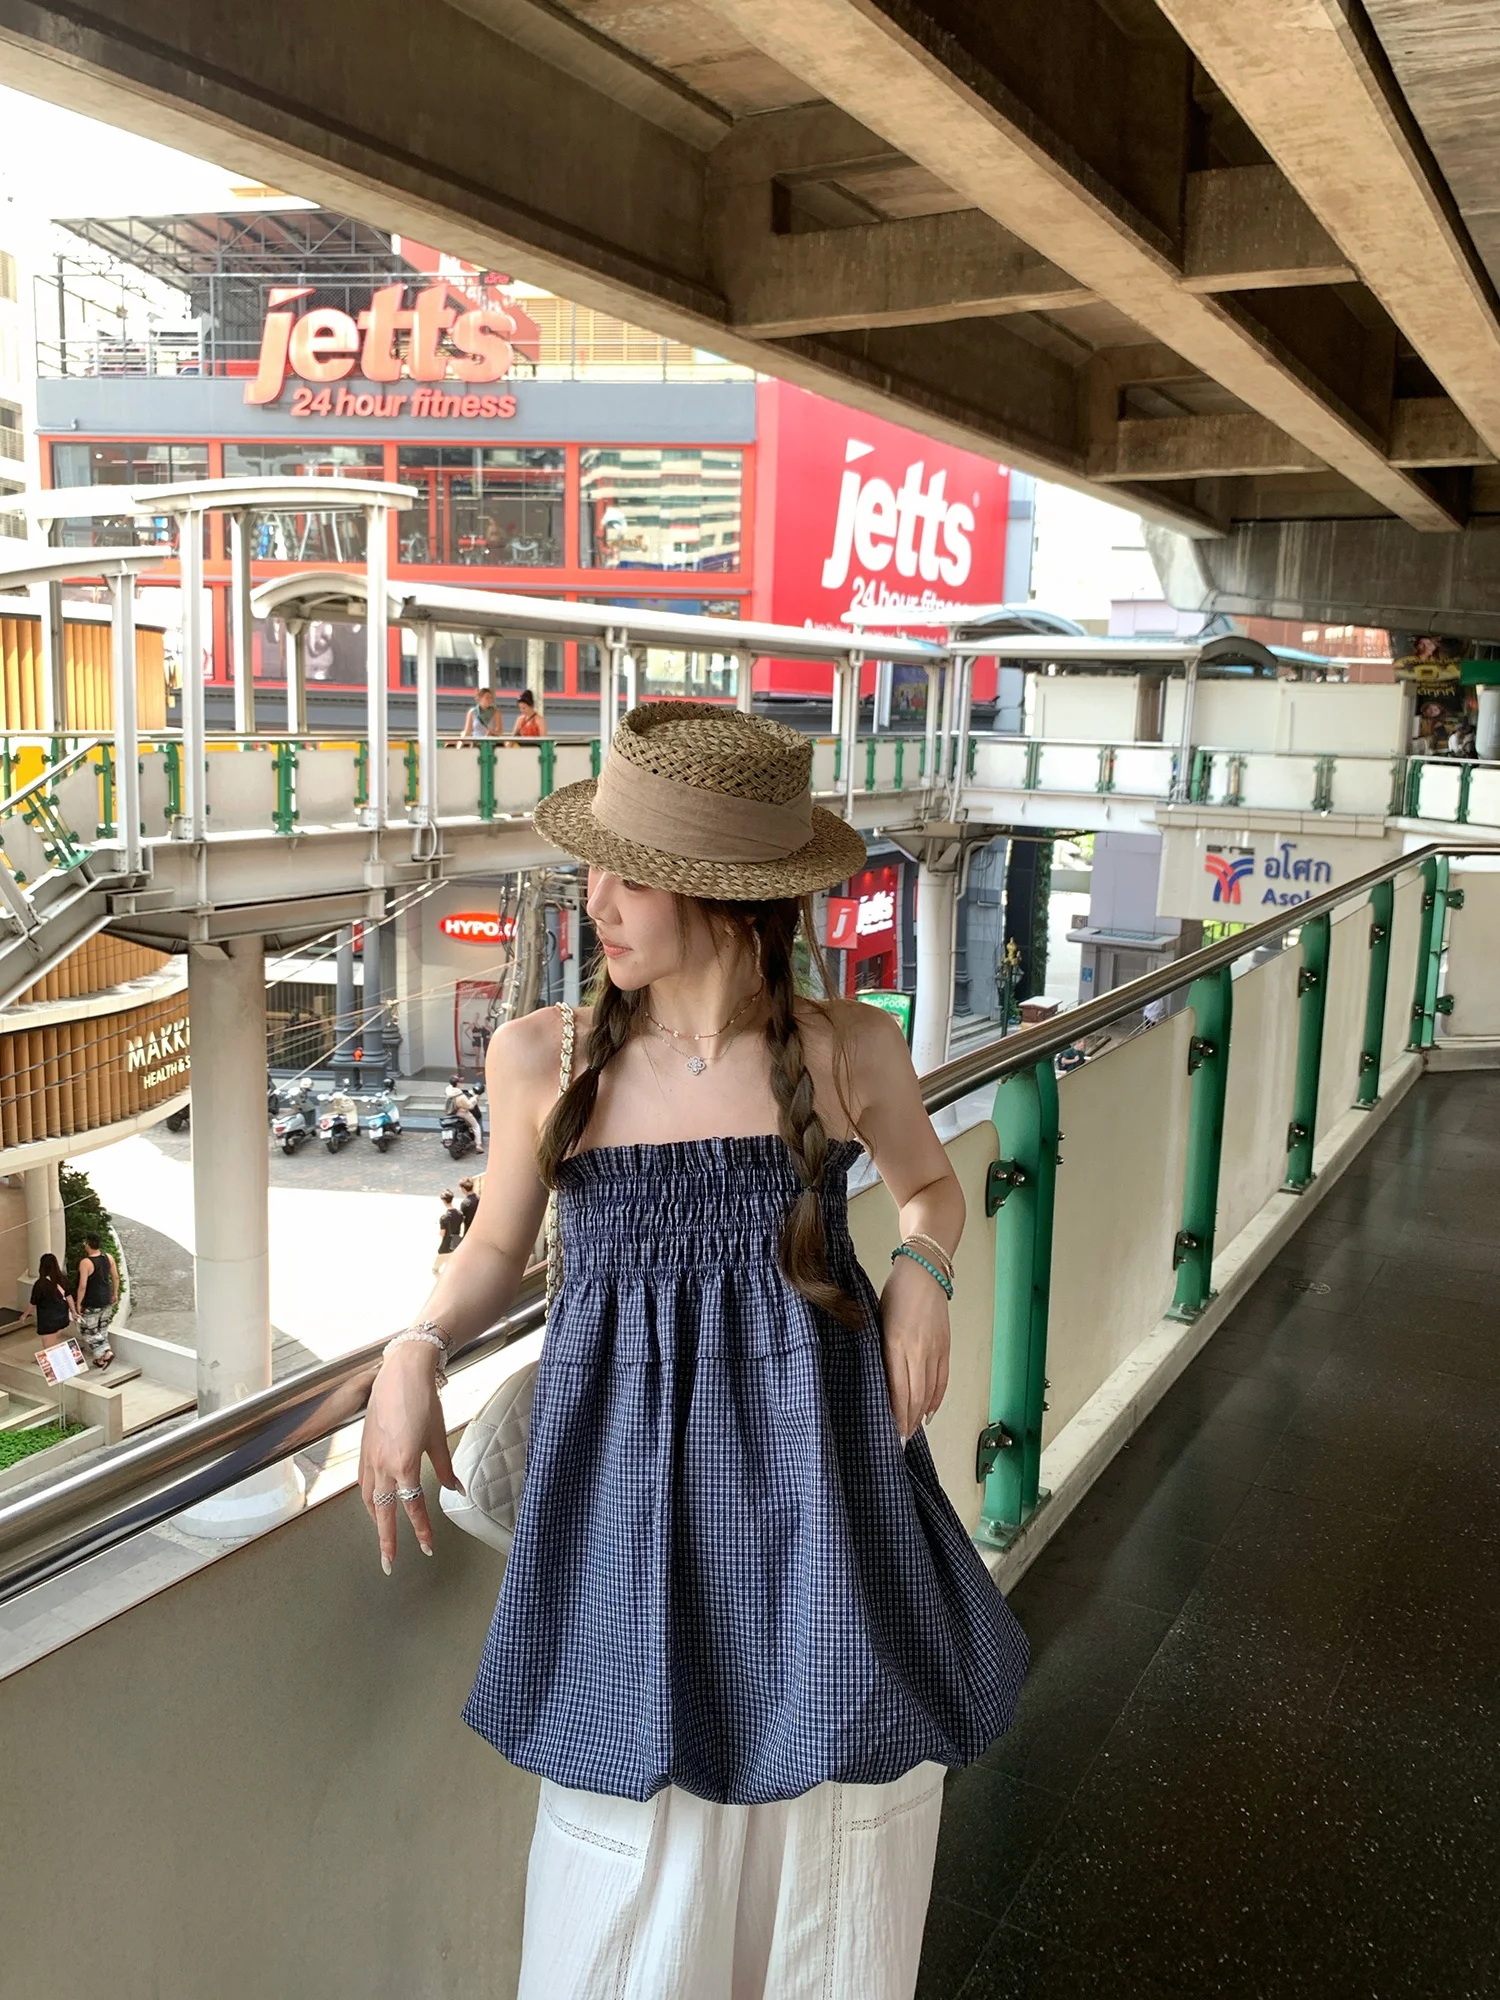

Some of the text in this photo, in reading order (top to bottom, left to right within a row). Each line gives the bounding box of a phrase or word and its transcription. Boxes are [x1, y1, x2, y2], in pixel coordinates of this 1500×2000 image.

[244, 284, 517, 405] jetts
[291, 387, 517, 418] 24 hour fitness
[821, 438, 976, 589] jetts
[850, 576, 877, 609] 24
[1264, 843, 1331, 884] อโศก
